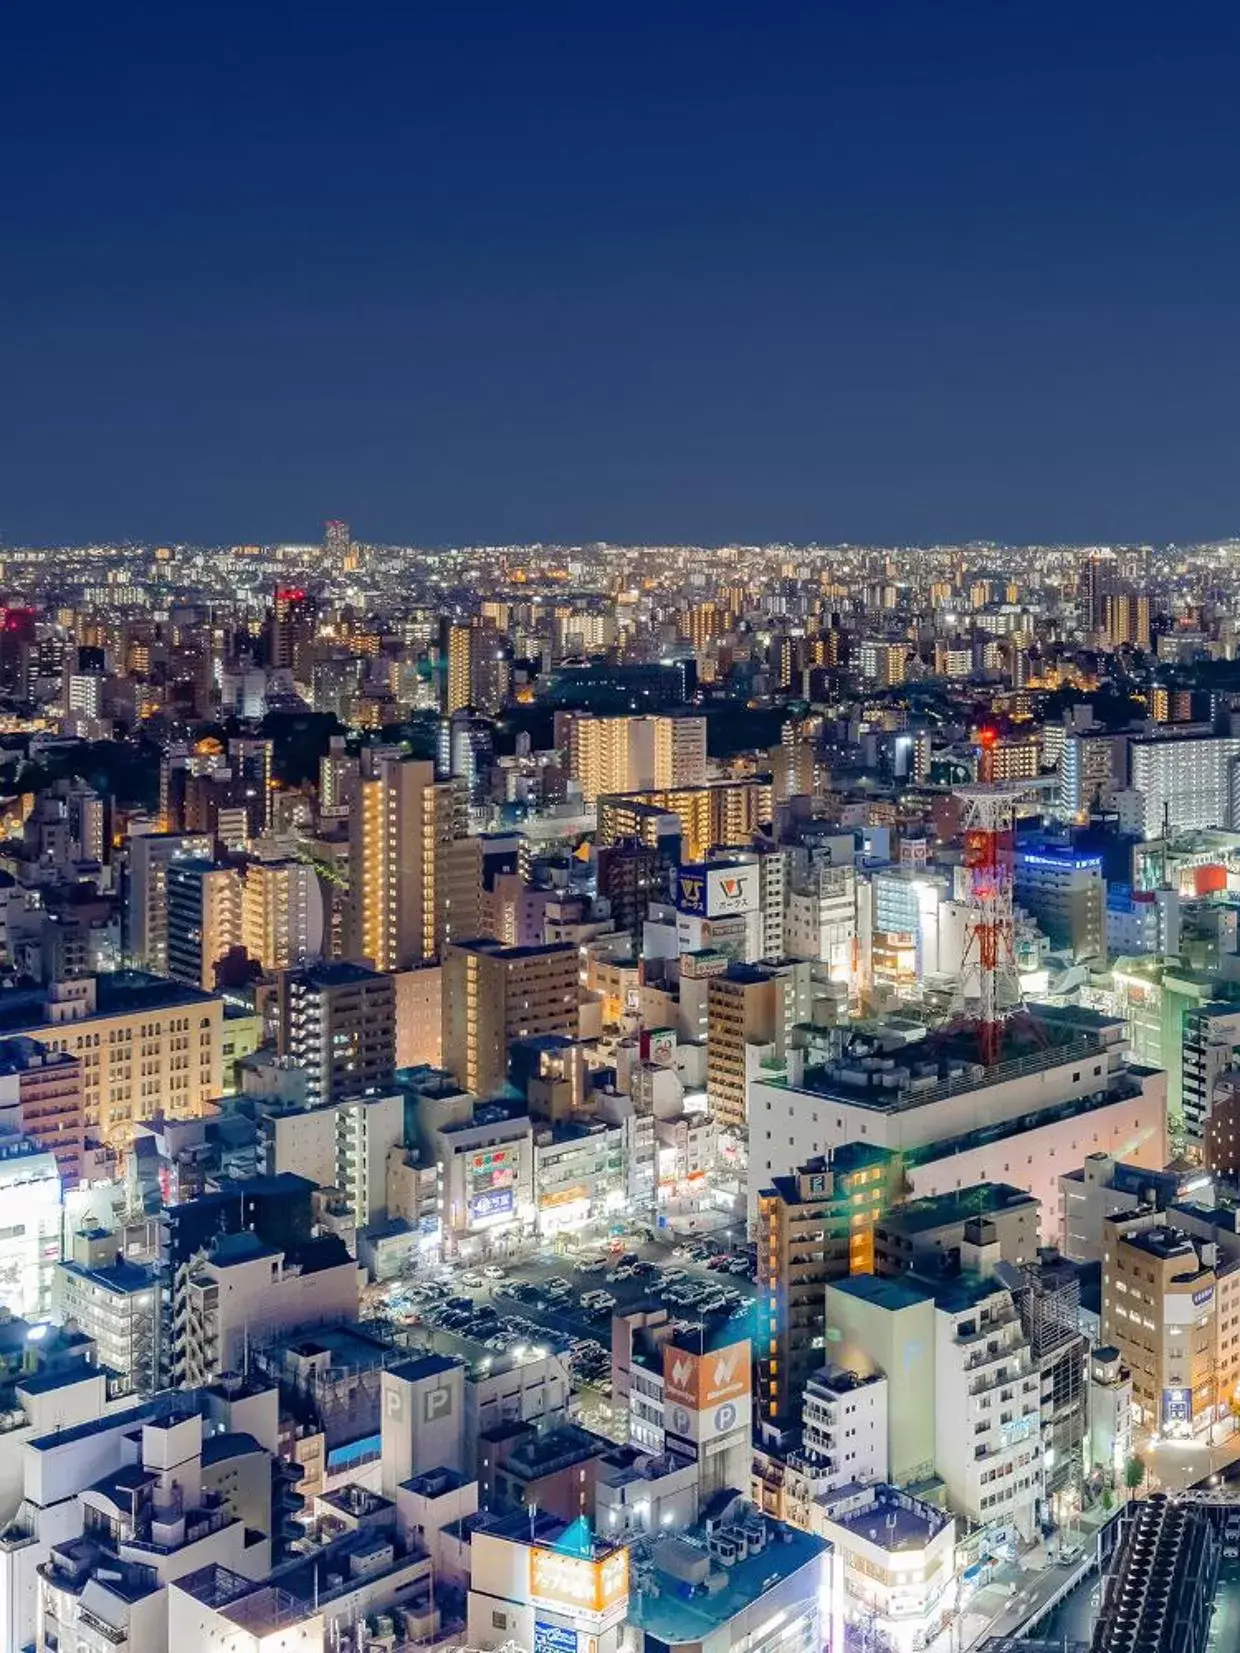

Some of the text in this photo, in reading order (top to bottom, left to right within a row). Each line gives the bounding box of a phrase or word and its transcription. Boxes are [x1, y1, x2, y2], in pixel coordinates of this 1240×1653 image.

[386, 1390, 401, 1416] P
[427, 1388, 449, 1420] P
[720, 1406, 732, 1430] P
